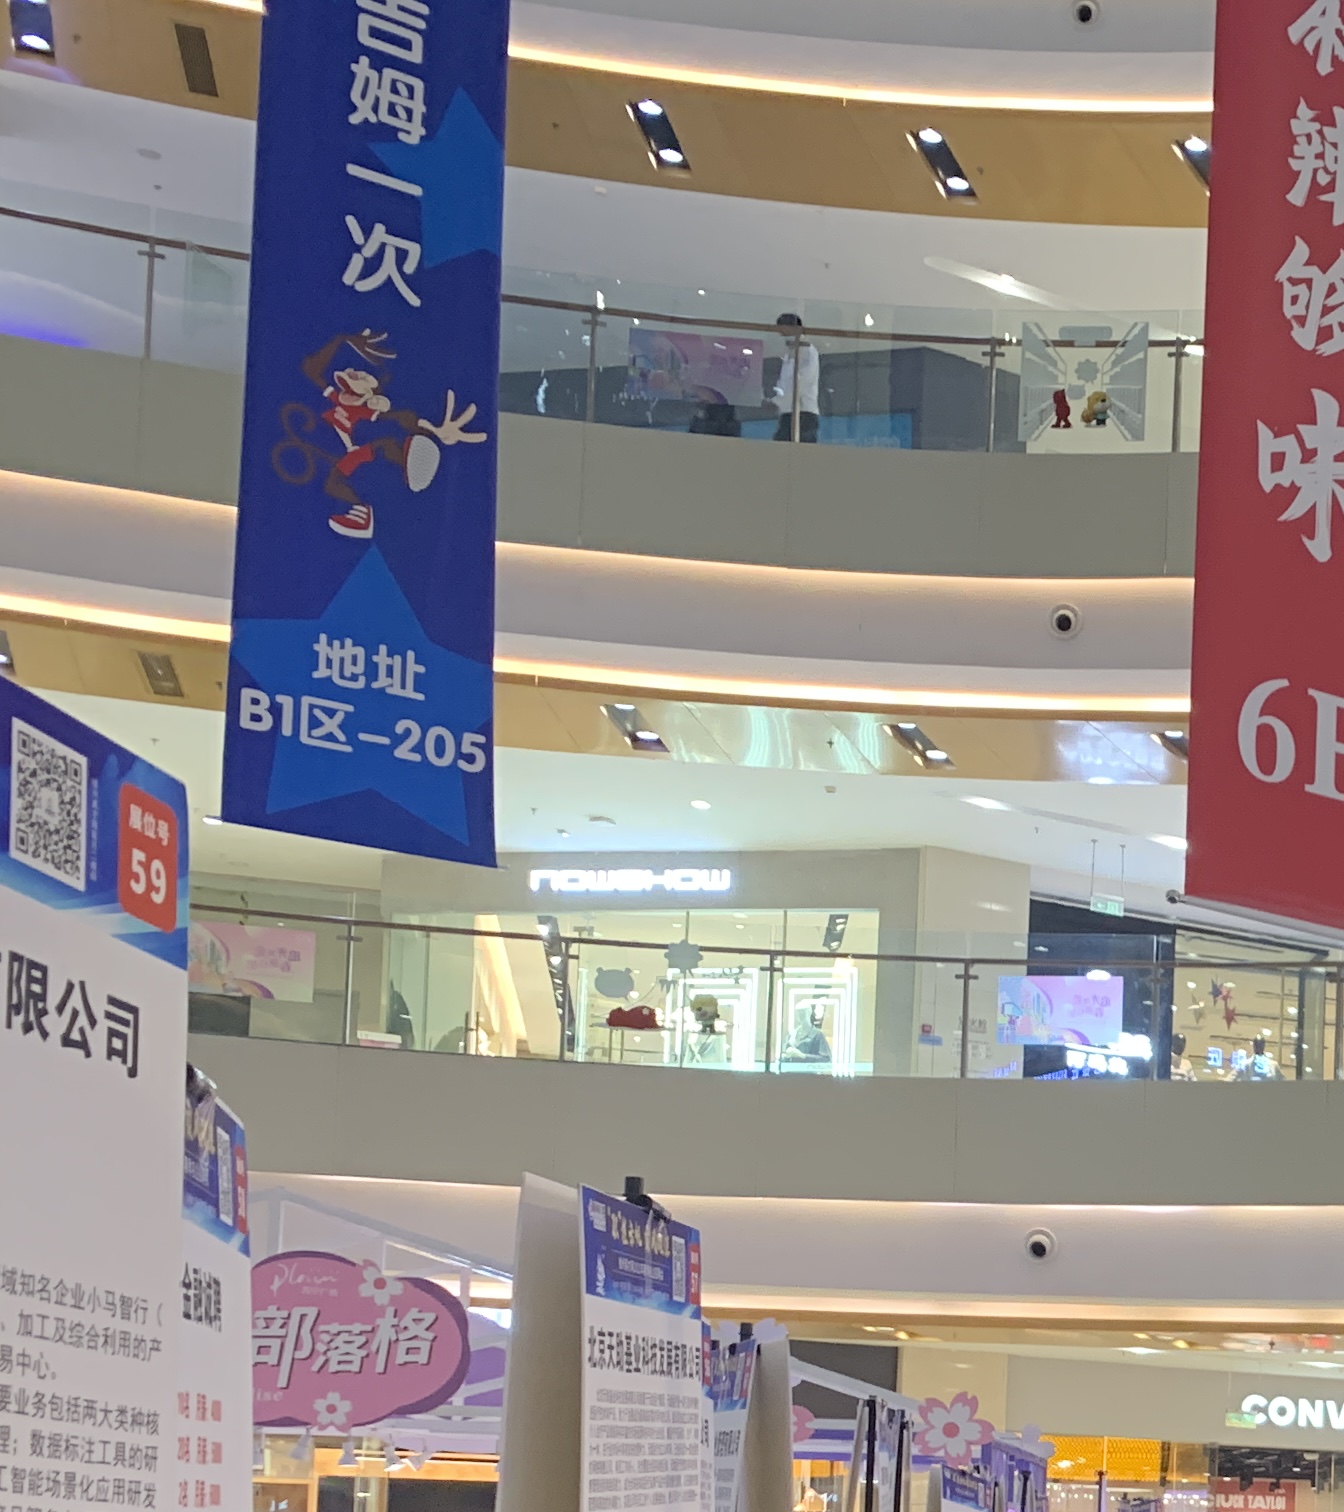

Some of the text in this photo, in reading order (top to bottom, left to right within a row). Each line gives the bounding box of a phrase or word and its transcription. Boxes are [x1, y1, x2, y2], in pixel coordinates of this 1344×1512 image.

[312, 632, 427, 703] 地址
[239, 687, 488, 773] B1区-205
[127, 802, 171, 847] 展位号
[129, 847, 167, 905] 59
[0, 946, 141, 1079] 限公司
[252, 1304, 439, 1390] 部落格
